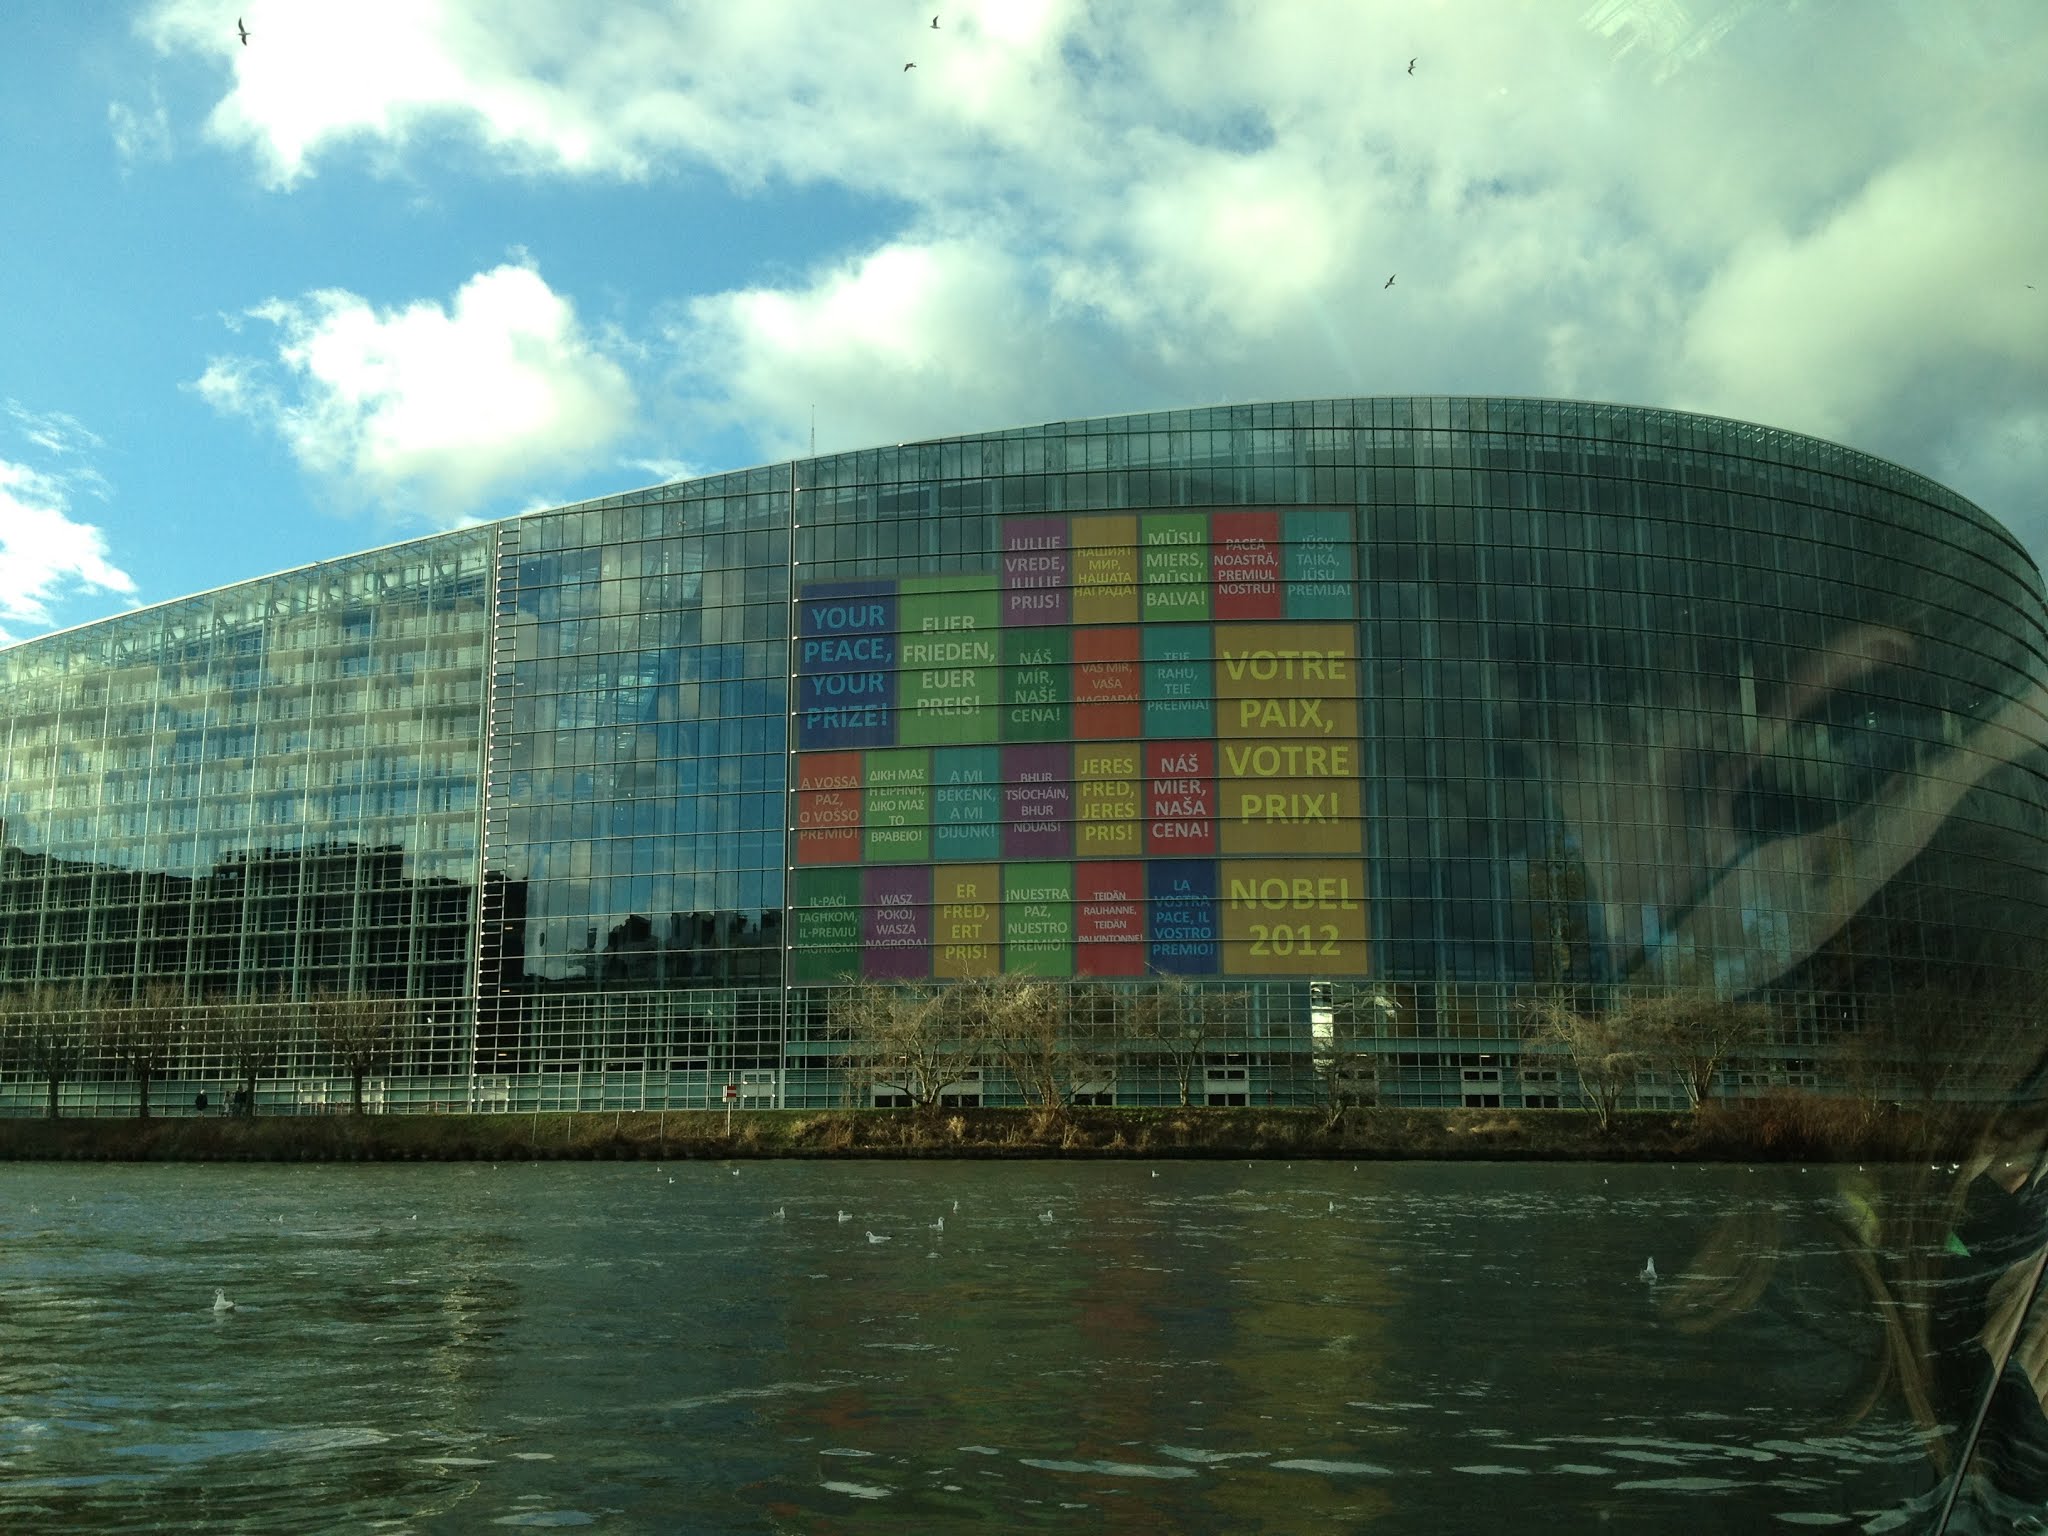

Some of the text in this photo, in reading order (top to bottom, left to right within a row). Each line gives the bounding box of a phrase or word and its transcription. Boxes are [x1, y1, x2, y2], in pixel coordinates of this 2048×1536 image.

[1010, 536, 1060, 550] JULLIE
[1149, 529, 1200, 545] MŪSU
[1226, 539, 1265, 550] PACEA
[1006, 557, 1064, 572] VREDE,
[1089, 560, 1120, 570] МИР,
[1147, 553, 1203, 567] MIERS,
[1214, 552, 1278, 566] NOASTRĂ,
[1296, 554, 1339, 566] TAIKA,
[1079, 573, 1131, 583] НАШАТА
[1219, 570, 1274, 580] PREMIUL
[1074, 585, 1136, 596] НАГРАДА!
[1219, 584, 1275, 594] NOSTRU!
[1288, 585, 1350, 596] PREMIJA!
[1011, 594, 1059, 609] PRIJS!
[1147, 591, 1205, 606] BALVA!
[812, 605, 885, 629] YOUR
[923, 616, 975, 635] EUER
[805, 638, 892, 663] PEACE,
[903, 642, 995, 662] FRIEDEN,
[1223, 651, 1346, 680] VOTRE
[922, 670, 975, 688] EUER
[1018, 668, 1054, 685] MÍR,
[1158, 668, 1198, 680] RAHU,
[813, 673, 884, 695] YOUR
[1164, 684, 1190, 694] TEIE
[1015, 687, 1056, 703] NAŠE
[917, 696, 980, 716] PREIS!
[1148, 701, 1208, 711] PREEMIA!
[807, 703, 887, 728] PRIZE!
[1012, 708, 1060, 722] CENA!
[1240, 699, 1333, 733] PAIX,
[1081, 758, 1133, 774] JERES
[1161, 754, 1198, 773] NÁŠ
[1226, 746, 1349, 776] VOTRE
[870, 769, 924, 781] ΔΙΚΗ ΜΑΣ
[950, 770, 982, 782] A MI
[801, 776, 858, 789] A VOSSA
[1083, 781, 1134, 798] FRED,
[1154, 780, 1206, 796] MIER,
[815, 794, 842, 806] PAZ,
[870, 800, 924, 811] ΔΙΚΟ ΜΑΣ
[1156, 797, 1205, 816] NAŠA
[950, 807, 982, 819] A MI
[1022, 806, 1053, 816] BHUR
[1083, 803, 1135, 818] JERES
[1241, 793, 1338, 824] PRIX!
[800, 809, 858, 823] O VOSSO
[889, 815, 904, 825] ΤΟ
[1014, 822, 1060, 832] NDUAIS!
[1085, 824, 1132, 841] PRIS!
[1153, 822, 1208, 838] CENA!
[871, 831, 921, 842] ΒΡΑΒΕΙΟ!
[957, 884, 976, 898] ER
[1174, 880, 1190, 891] LA
[881, 894, 912, 904] WASZ
[1155, 895, 1210, 908] VOSTRA
[1231, 879, 1358, 910] NOBEL
[943, 905, 989, 920] FRED,
[1025, 906, 1051, 917] PAZ,
[1084, 906, 1136, 915] RAUHANNE,
[1157, 912, 1209, 924] PACE, IL
[800, 926, 856, 938] IL-PREMJU
[876, 924, 916, 935] WASZA
[952, 924, 982, 938] ERT
[1008, 922, 1067, 934] NUESTRO
[1155, 928, 1211, 939] VOSTRO
[1011, 939, 1065, 951] PREMIO!
[1250, 924, 1340, 955] 2012
[945, 946, 986, 959] PRIS!
[1153, 944, 1213, 955] PREMIO!
